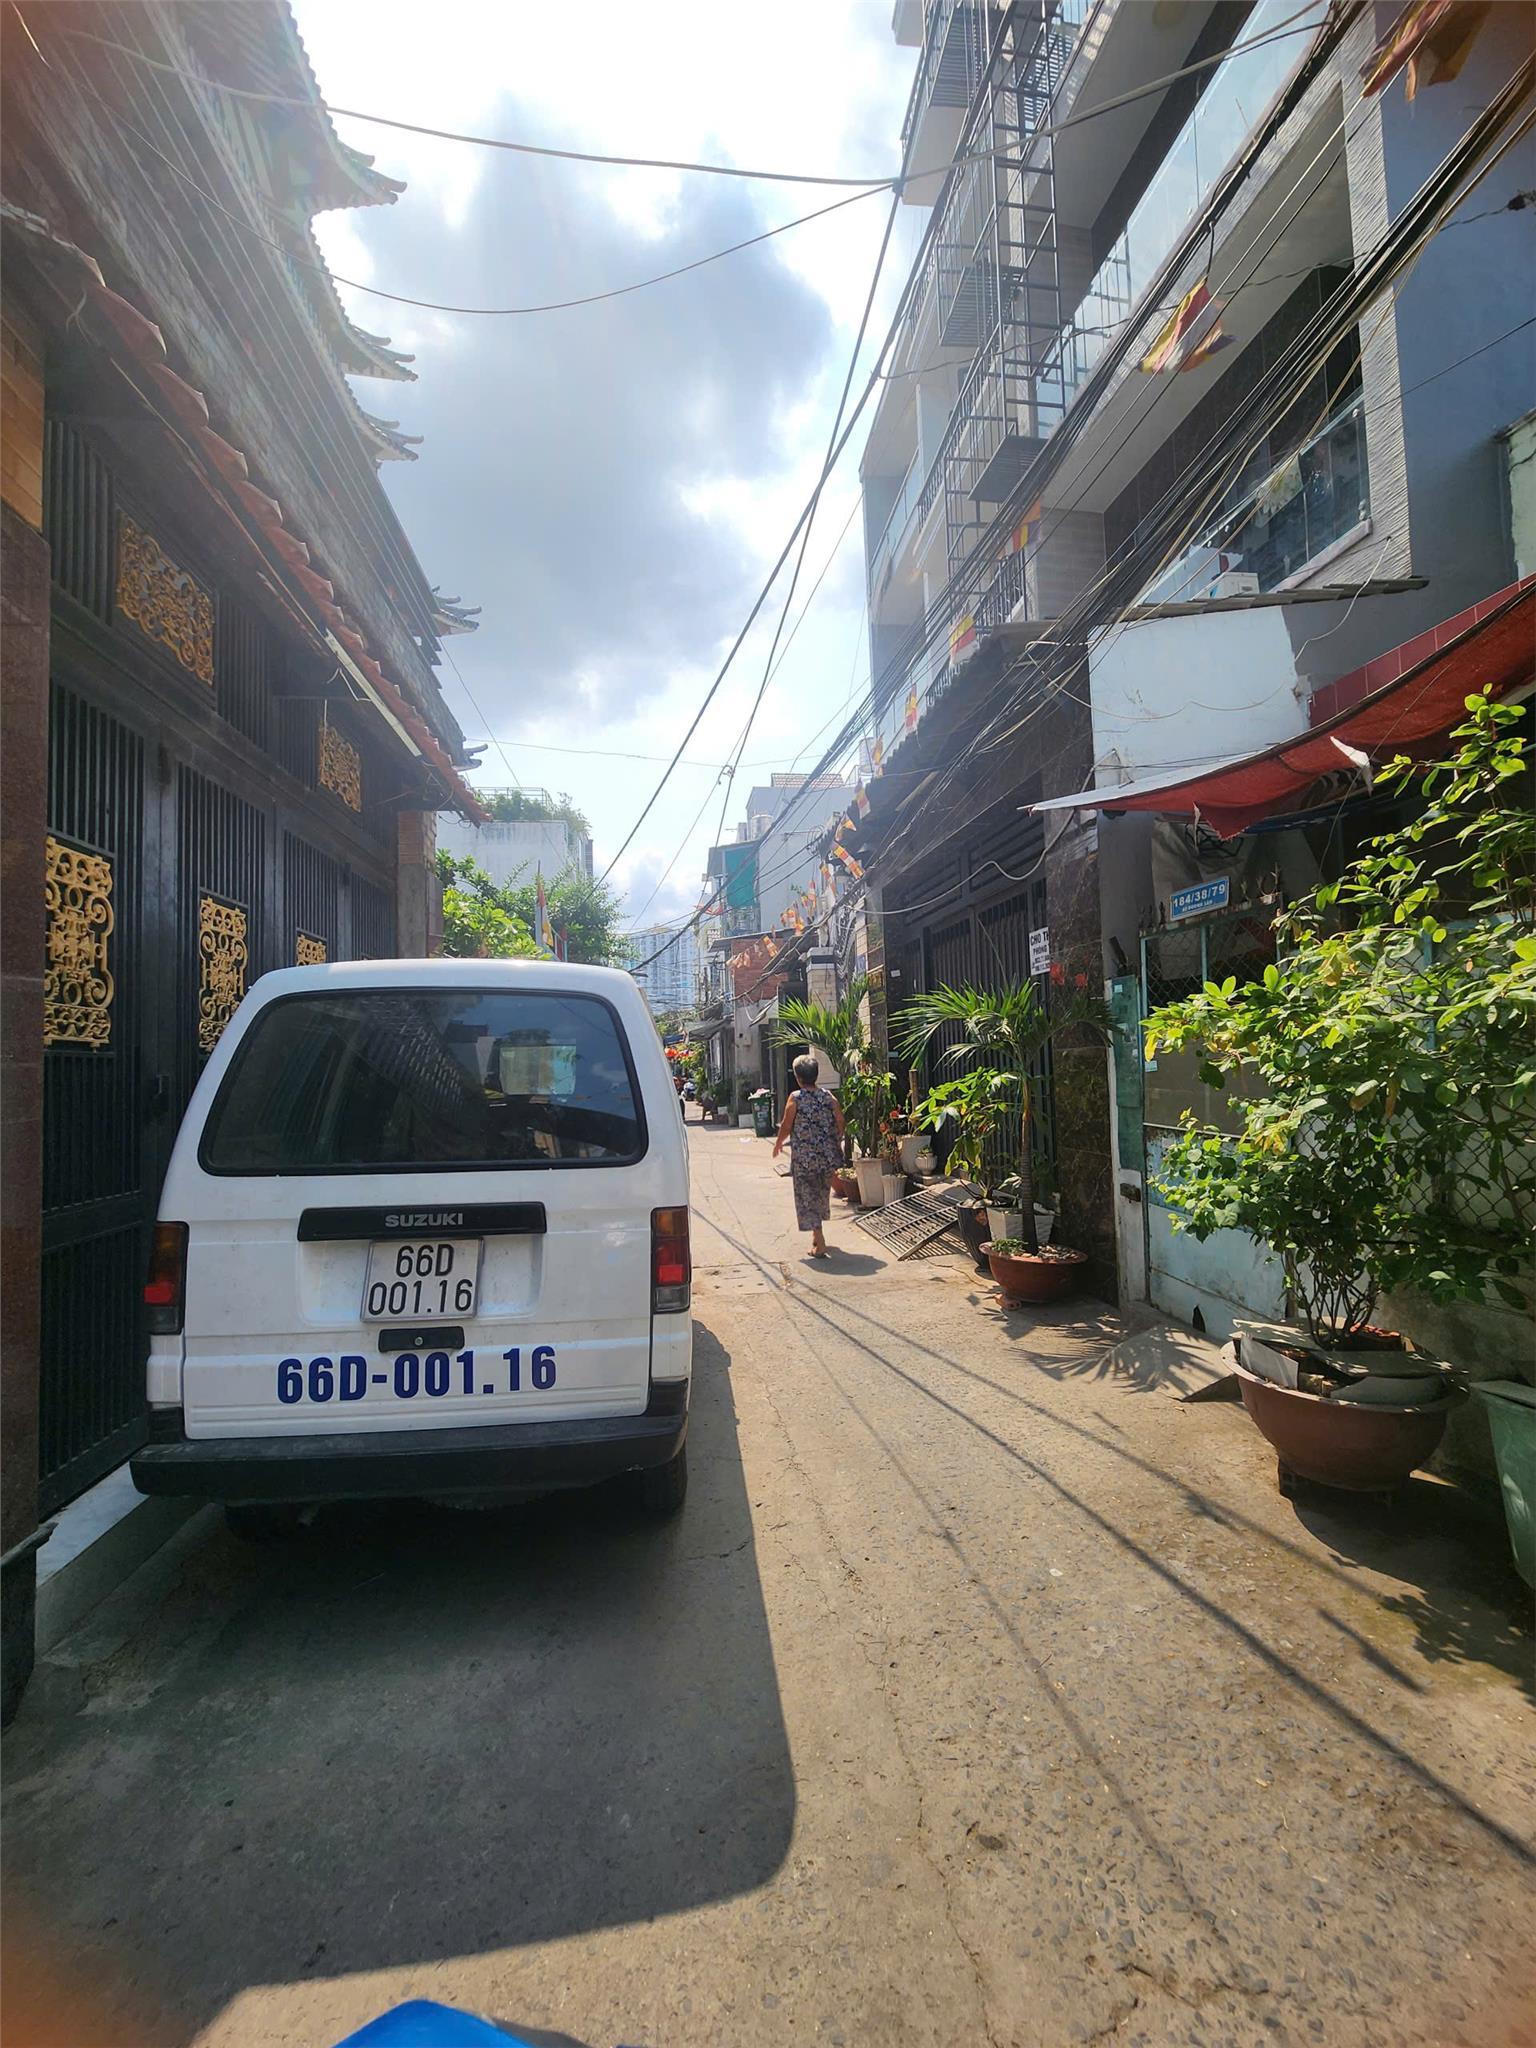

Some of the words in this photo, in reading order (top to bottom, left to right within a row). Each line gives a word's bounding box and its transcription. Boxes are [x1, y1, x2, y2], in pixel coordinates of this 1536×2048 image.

[1173, 884, 1226, 908] 184/38/79
[1030, 933, 1042, 946] CHO
[384, 1212, 464, 1228] SUZUKI
[395, 1243, 455, 1278] 66D
[368, 1279, 473, 1316] 001.16
[277, 1345, 557, 1404] 66D-001.16
